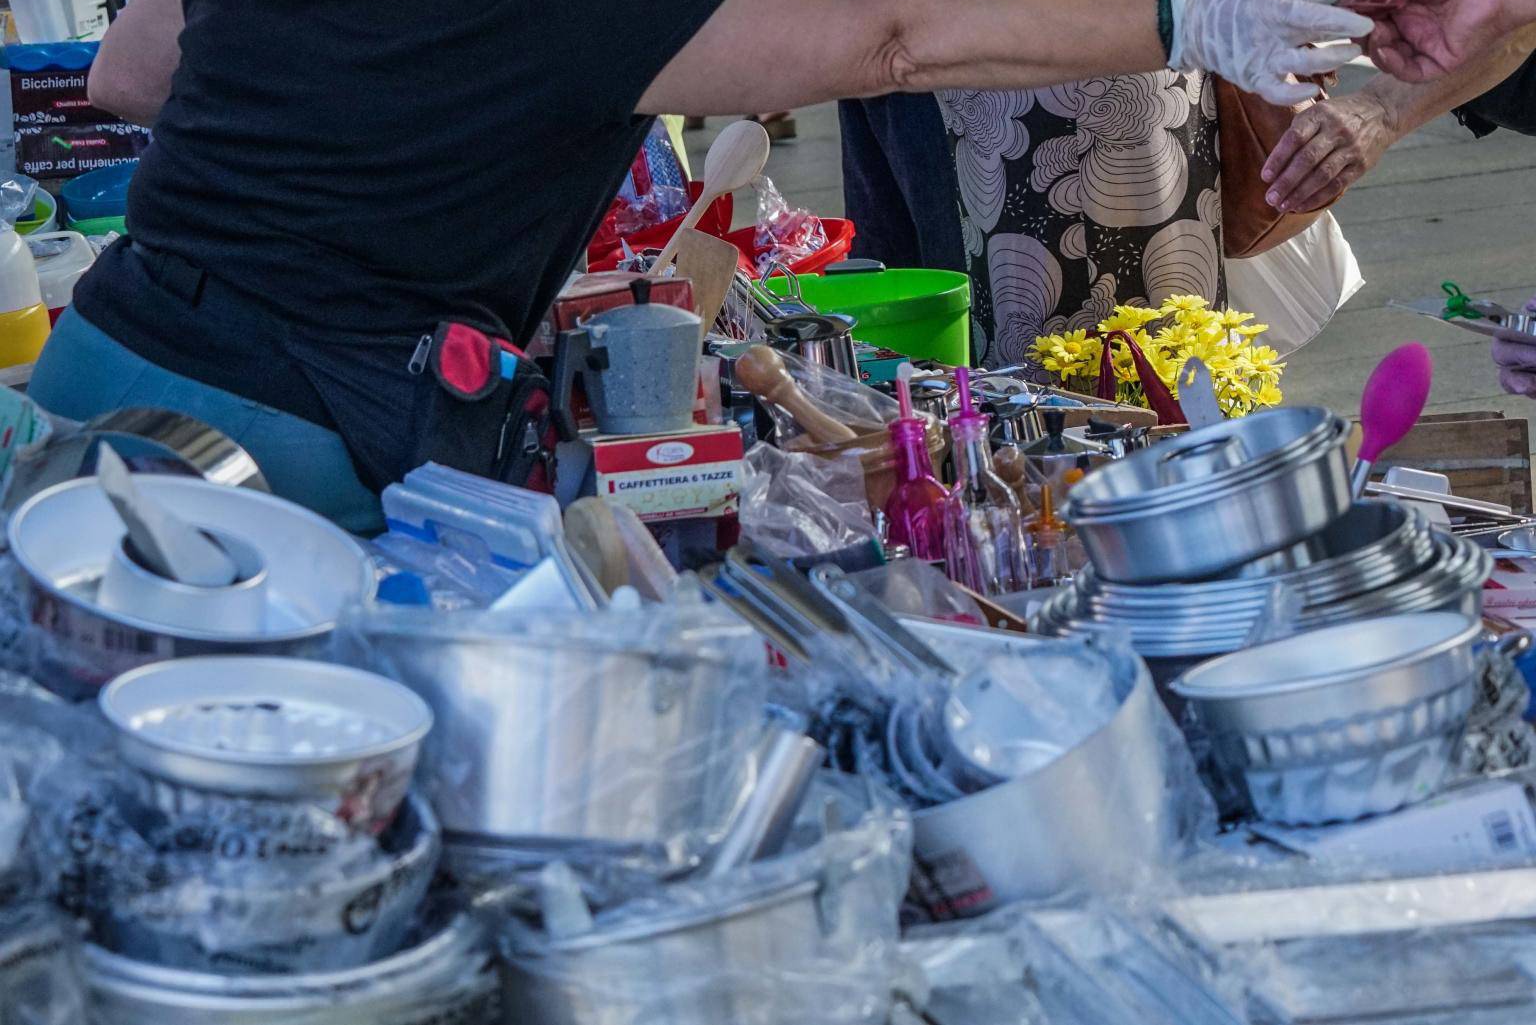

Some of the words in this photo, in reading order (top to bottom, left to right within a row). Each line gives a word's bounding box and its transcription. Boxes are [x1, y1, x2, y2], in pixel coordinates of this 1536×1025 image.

[21, 76, 85, 90] Bicchierini
[24, 161, 54, 174] caffè
[56, 158, 76, 170] per
[618, 477, 689, 490] CAFFETTIERA
[701, 470, 733, 482] TAZZE
